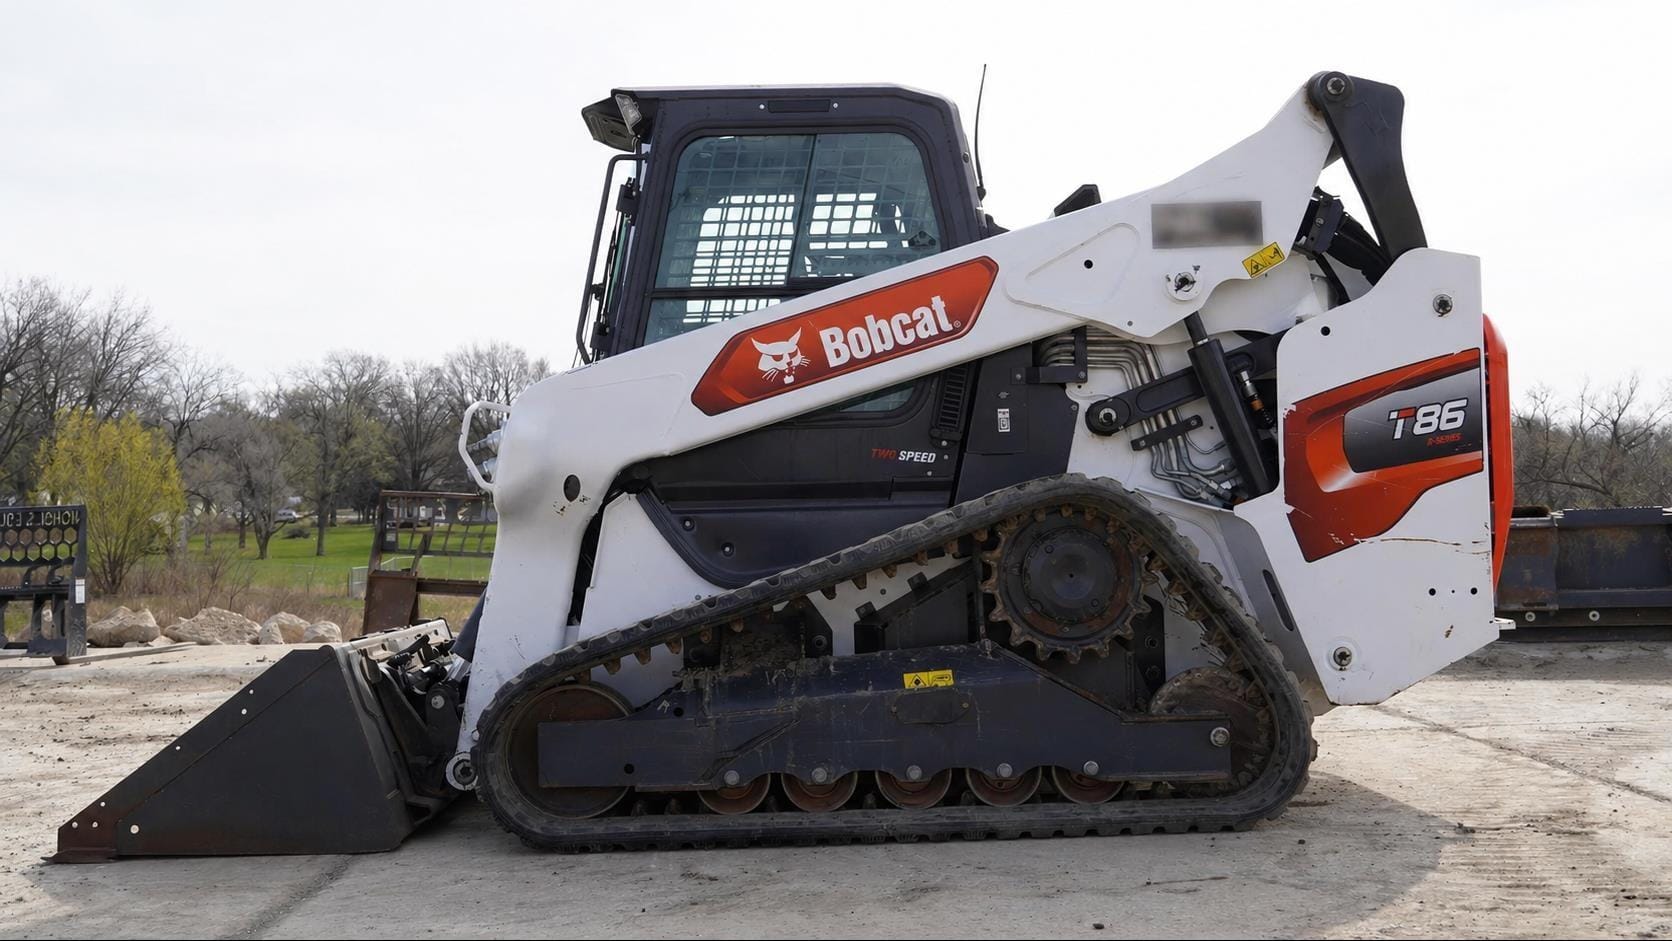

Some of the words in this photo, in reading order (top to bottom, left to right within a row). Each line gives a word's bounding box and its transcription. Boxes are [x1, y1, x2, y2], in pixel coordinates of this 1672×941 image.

[819, 295, 953, 368] Bobcat
[1388, 398, 1468, 440] T86
[871, 448, 897, 460] TWO
[898, 450, 936, 463] SPEED
